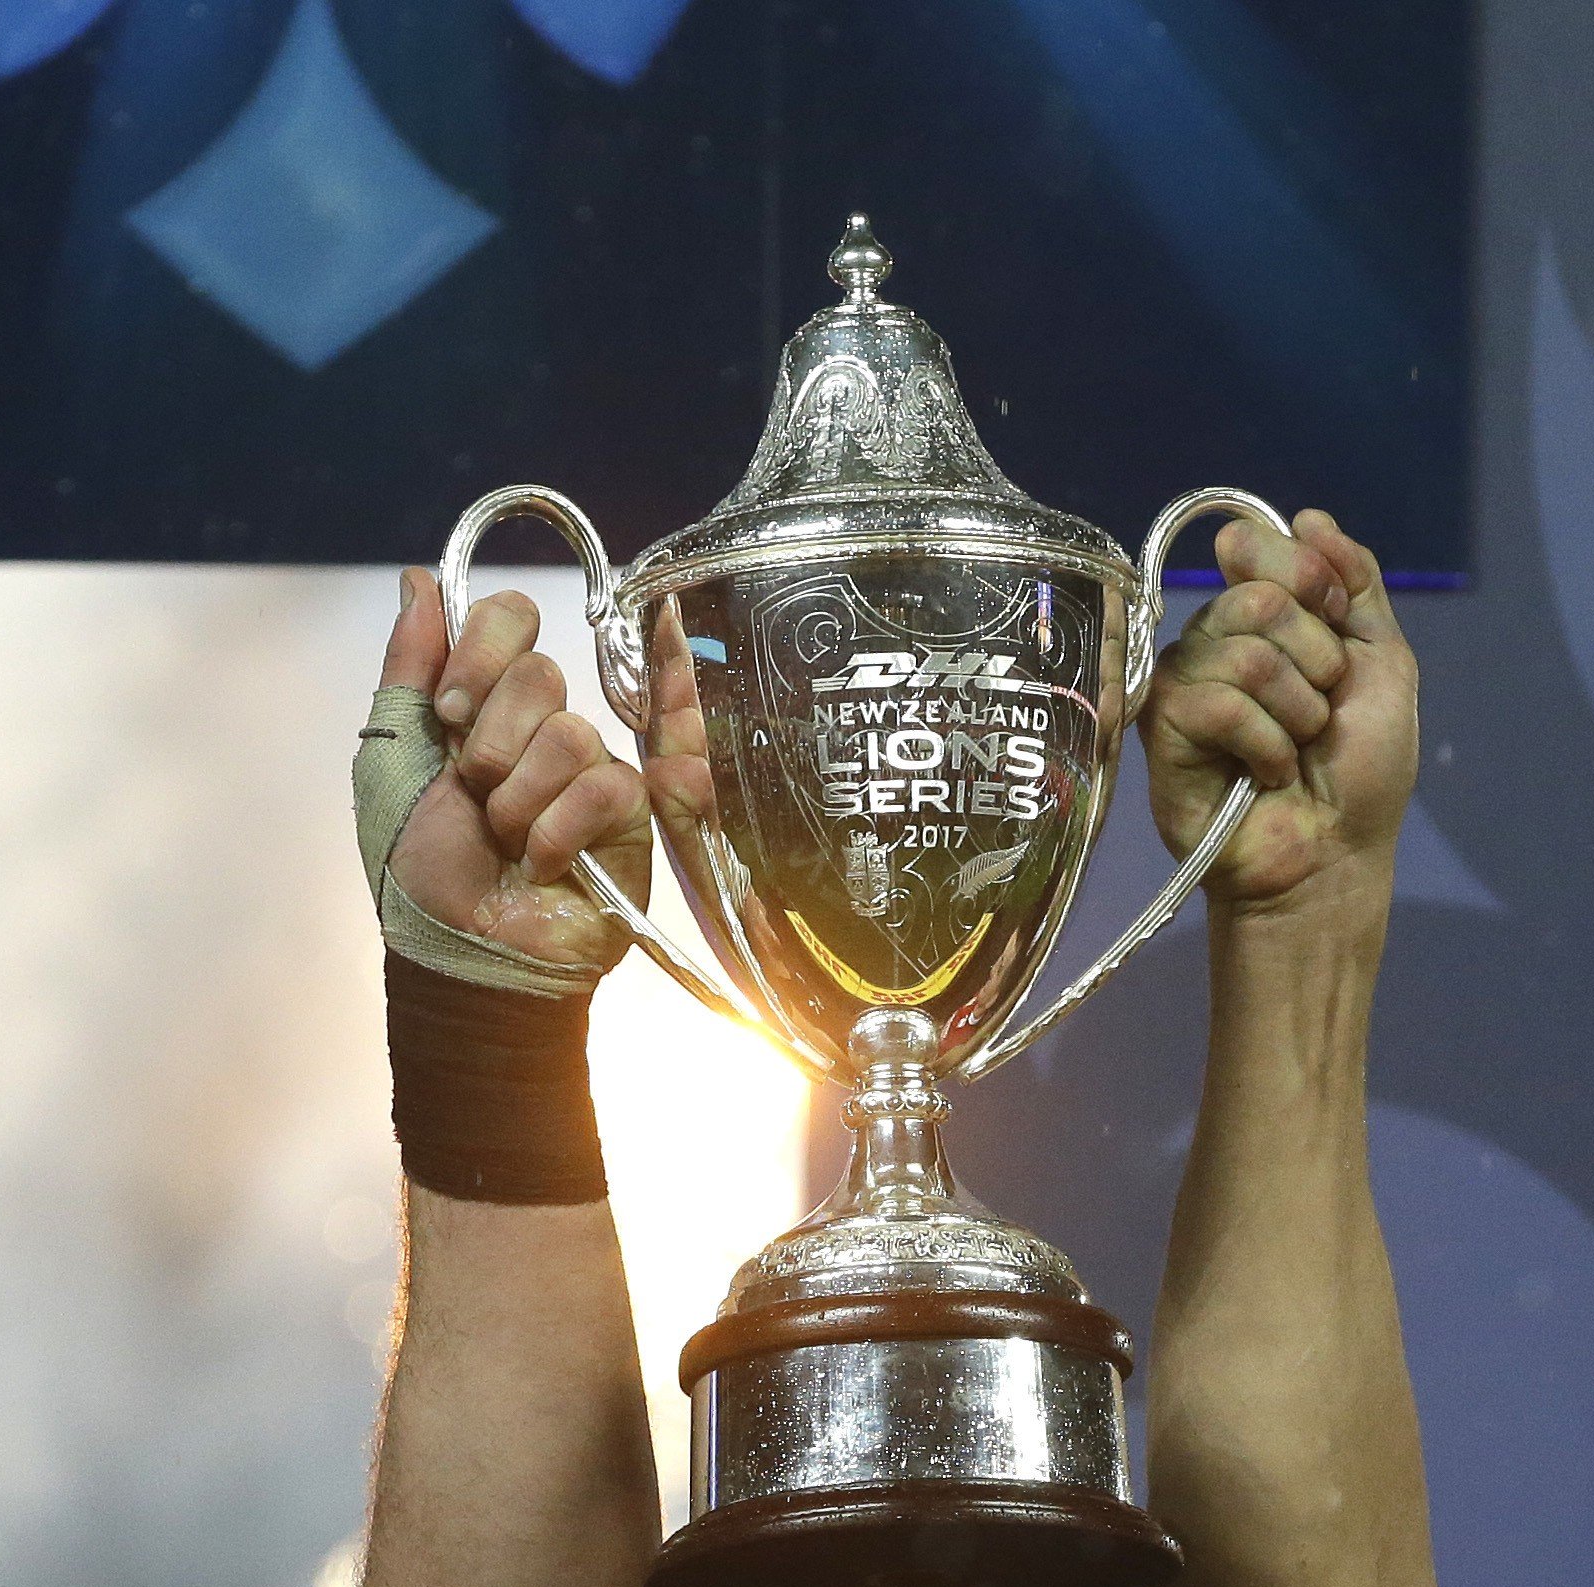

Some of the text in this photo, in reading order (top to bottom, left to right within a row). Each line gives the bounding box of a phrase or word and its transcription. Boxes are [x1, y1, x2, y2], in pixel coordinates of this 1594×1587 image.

[843, 651, 1025, 692] DHL
[813, 701, 1050, 731] NEW ZEALAND
[815, 730, 1046, 778] LIONS
[822, 779, 1041, 820] SERIES
[903, 825, 969, 849] 2017
